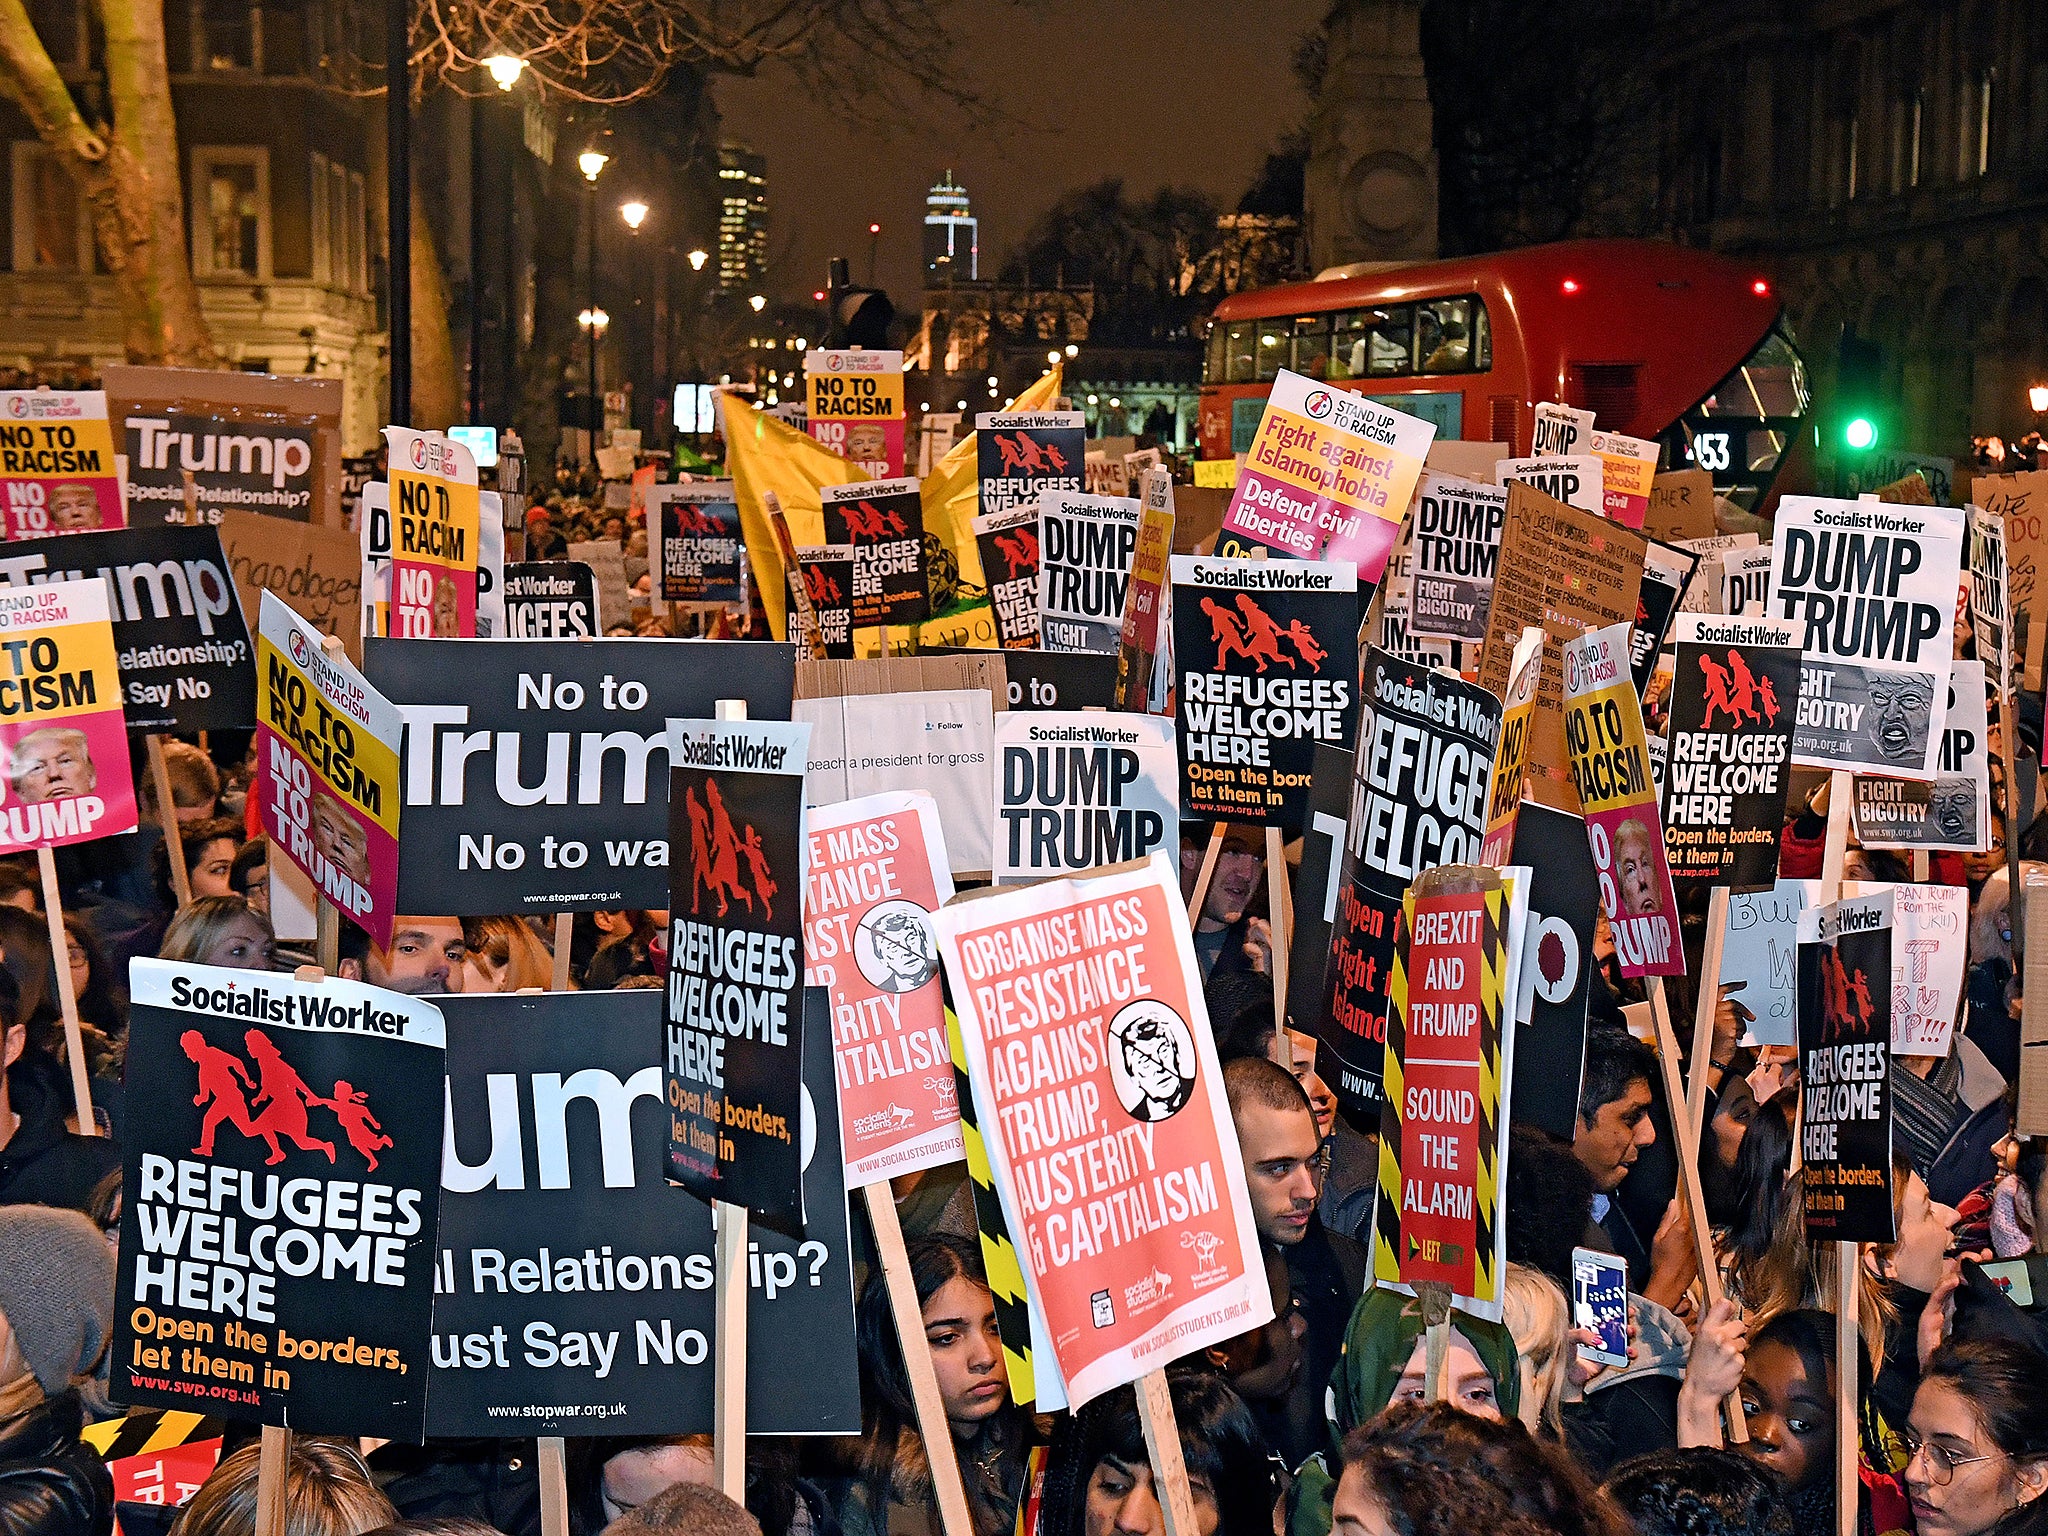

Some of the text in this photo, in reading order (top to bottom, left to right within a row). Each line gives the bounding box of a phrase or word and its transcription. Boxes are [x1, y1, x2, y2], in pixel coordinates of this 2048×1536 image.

[815, 378, 876, 396] NO TO
[815, 398, 892, 415] RACISM
[1337, 400, 1395, 429] STAND UP
[0, 426, 76, 449] NO TO
[815, 423, 845, 442] NO
[1265, 415, 1316, 452] Fight
[1319, 440, 1395, 480] against
[1333, 413, 1396, 446] TO RACISM
[1536, 418, 1577, 456] DUMP
[4, 450, 101, 473] RACISM
[125, 417, 311, 488] Trump
[984, 477, 1080, 495] REFUGEES
[1256, 441, 1389, 508] Islamophobia
[6, 482, 44, 506] NO
[398, 479, 430, 518] NO
[1242, 478, 1362, 541] Defend civil
[1605, 495, 1628, 509] civil
[11, 507, 47, 530] TO
[1233, 503, 1316, 552] liberties
[1418, 496, 1505, 542] DUMP
[665, 538, 737, 552] REFUGEES
[665, 550, 733, 565] WELCOME
[1044, 516, 1138, 571] DUMP
[1690, 537, 1737, 552] THERESA
[1781, 527, 1923, 598] DUMP
[400, 567, 433, 606] NO
[665, 562, 703, 577] HERE
[38, 592, 58, 607] UP
[1418, 579, 1457, 601] FIGHT
[13, 607, 68, 625] RACISM
[399, 605, 431, 638] TO
[1417, 599, 1475, 622] BIGOTRY
[1776, 588, 1942, 663] TRUMP
[1046, 621, 1088, 647] FIGHT
[2, 637, 59, 677] TO
[311, 650, 366, 702] STAND UP
[1589, 658, 1618, 684] RACISM
[129, 678, 211, 709] Say No
[268, 652, 355, 759] NO TO
[311, 668, 370, 725] TO RACISM
[517, 673, 649, 711] No to
[1030, 678, 1058, 707] to
[1185, 671, 1350, 711] REFUGEES
[937, 721, 964, 731] Follow
[1184, 702, 1343, 741] WELCOME
[1565, 699, 1623, 757] NO TO
[270, 686, 382, 818] RACISM
[849, 749, 985, 773] a president for gross
[1186, 733, 1271, 768] HERE
[1499, 717, 1523, 770] NO
[1673, 732, 1788, 764] REFUGEES
[270, 736, 312, 790] NO
[1001, 746, 1141, 809] DUMP
[1187, 763, 1268, 787] Open the
[1571, 745, 1647, 803] RACISM
[1671, 763, 1779, 795] WELCOME
[270, 770, 311, 831] TO
[1190, 782, 1284, 806] let them in
[1190, 801, 1267, 818] www.swp.org.uk
[1667, 795, 1733, 825] HERE
[1858, 781, 1906, 803] FIGHT
[1859, 801, 1930, 824] BIGOTRY
[458, 834, 589, 871] No to
[826, 820, 900, 863] MASS
[999, 808, 1164, 870] TRUMP
[1665, 827, 1775, 848] Open the borders,
[1863, 827, 1924, 840] www.swp.org.uk
[271, 803, 374, 918] TRUMP
[1686, 848, 1734, 865] them in
[523, 890, 622, 903] www.stopwar.org.uk
[1344, 883, 1384, 939] Open
[1895, 886, 1960, 902] BAN TRUMP
[1897, 902, 1945, 914] FROM THE
[960, 896, 1149, 982] ORGANISE MASS
[1414, 910, 1483, 947] BREXIT
[671, 918, 797, 991] REFUGEES
[1337, 940, 1377, 993] Fight
[976, 943, 1152, 1042] RESISTANCE
[1424, 957, 1465, 991] AND
[669, 971, 788, 1047] WELCOME
[1411, 1003, 1478, 1038] TRUMP
[667, 1024, 725, 1090] HERE
[989, 1016, 1108, 1103] AGAINST
[1808, 1043, 1886, 1086] REFUGEES
[668, 1079, 792, 1145] Open the borders,
[853, 1110, 890, 1128] socialist
[999, 1080, 1109, 1160] TRUMP,
[1406, 1086, 1475, 1125] SOUND
[1806, 1083, 1882, 1122] WELCOME
[671, 1113, 735, 1163] let them in
[855, 1119, 893, 1136] students
[1803, 1124, 1838, 1161] HERE
[1014, 1121, 1157, 1220] AUSTERITY
[1419, 1134, 1459, 1171] THE
[141, 1153, 422, 1236] REFUGEES
[1838, 1164, 1885, 1188] borders,
[1403, 1178, 1473, 1221] ALARM
[1027, 1161, 1220, 1279] & CAPITALISM
[136, 1203, 407, 1287] WELCOME
[134, 1254, 277, 1324] HERE
[131, 1306, 409, 1376] Open the borders,
[523, 1319, 709, 1380] Say No
[1130, 1300, 1252, 1361] WWW.SOCIALISTSTUDENTS.ORG.UK
[133, 1340, 292, 1391] let them in
[130, 1374, 261, 1407] www.swp.org.uk
[487, 1402, 628, 1419] www.stopwar.org.uk
